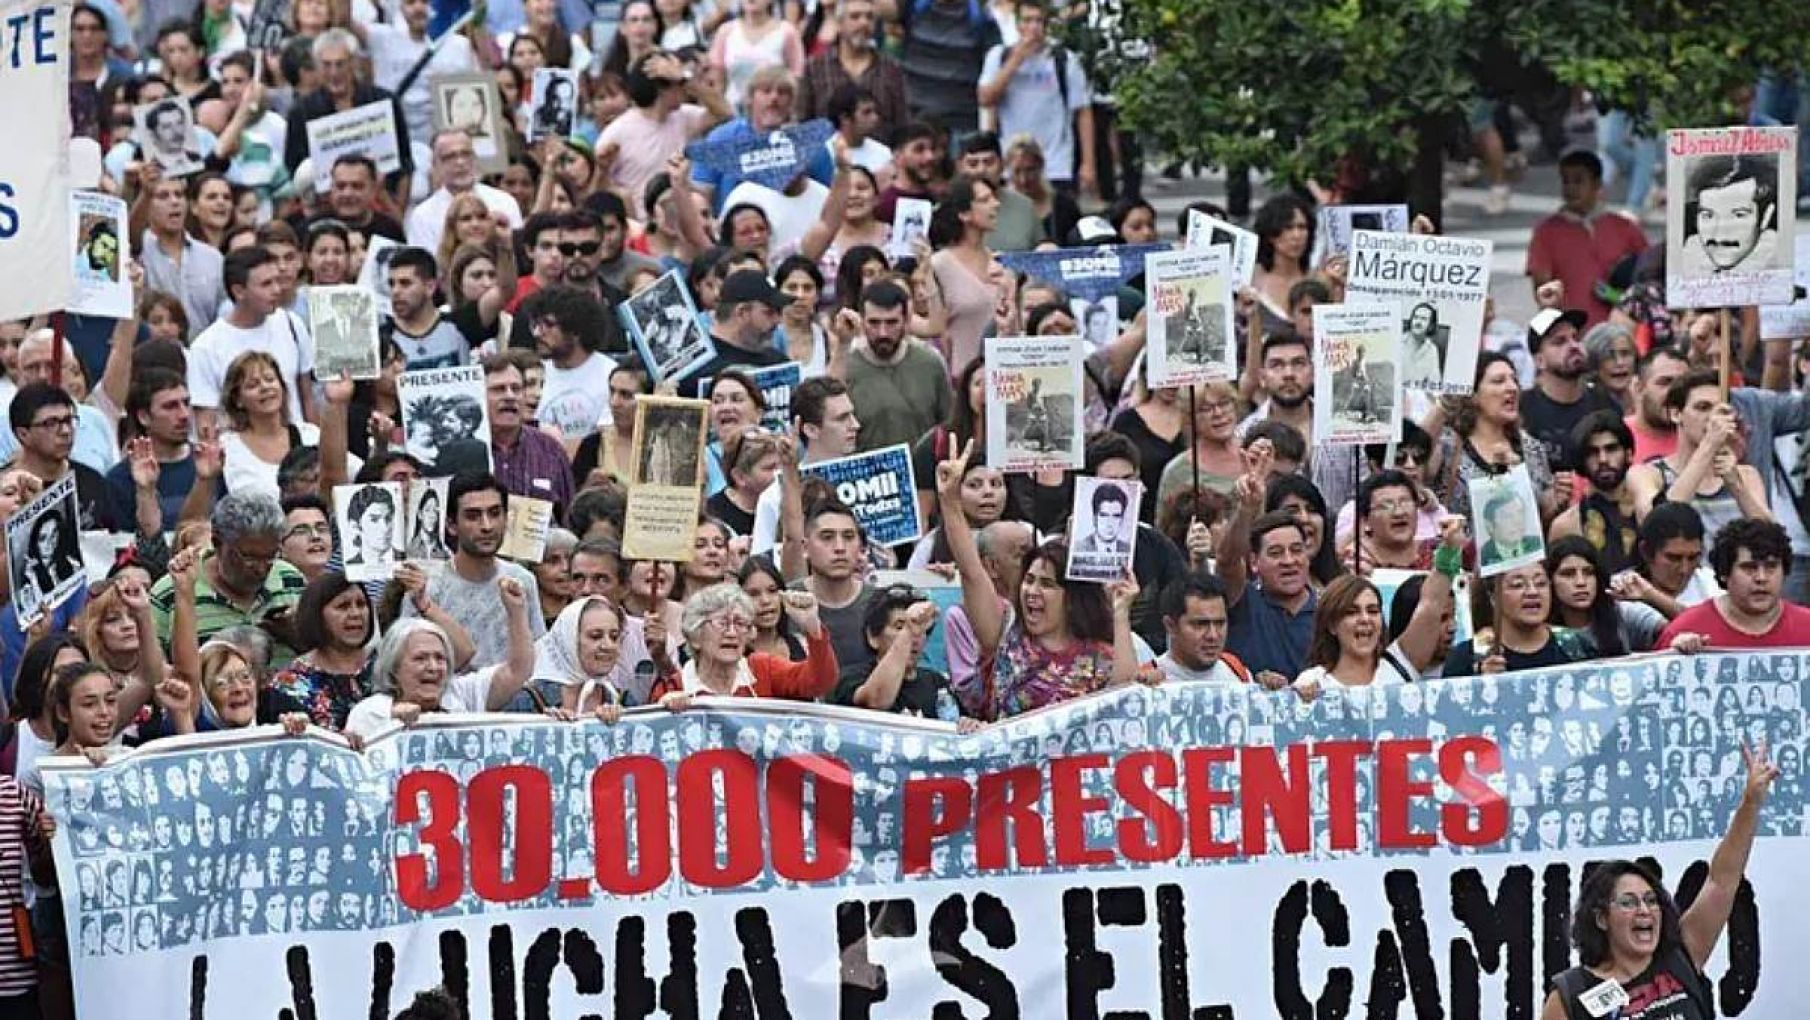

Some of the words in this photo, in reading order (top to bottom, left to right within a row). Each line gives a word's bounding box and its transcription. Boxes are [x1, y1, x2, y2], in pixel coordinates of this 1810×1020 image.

[0, 8, 57, 68] TE
[1354, 250, 1482, 288] Márquez
[1355, 231, 1418, 253] Damián
[1423, 237, 1485, 257] Octavio
[399, 369, 483, 389] PRESENTE
[7, 478, 75, 533] PRESENTE
[396, 748, 854, 911] 30.000
[902, 736, 1510, 876] PRESENTES
[836, 890, 1020, 1020] ES
[1062, 882, 1235, 1020] EL
[1272, 856, 1761, 1020] CAMIO
